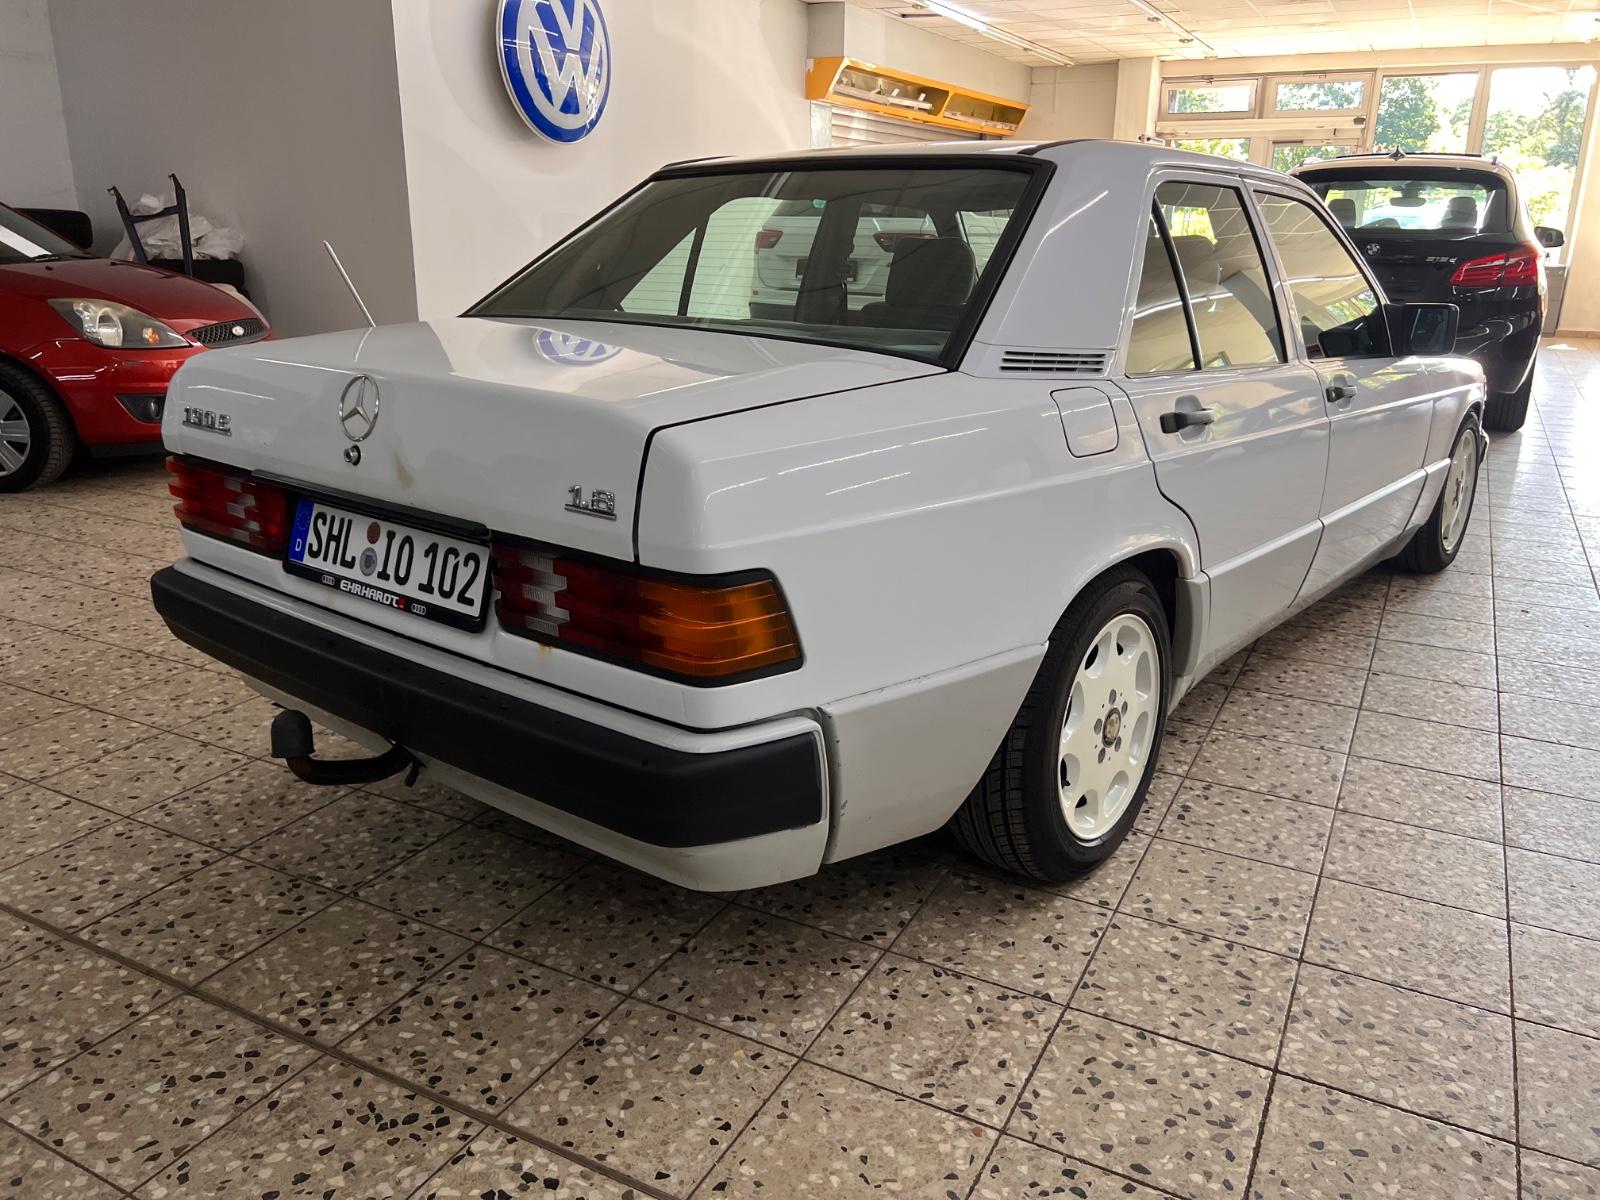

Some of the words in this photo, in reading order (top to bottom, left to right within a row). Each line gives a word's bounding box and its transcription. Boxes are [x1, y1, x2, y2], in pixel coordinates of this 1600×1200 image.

[295, 538, 303, 552] D
[307, 511, 356, 569] SHL
[376, 529, 414, 586] IO
[418, 542, 481, 607] 102
[340, 580, 400, 608] EHRHARDT
